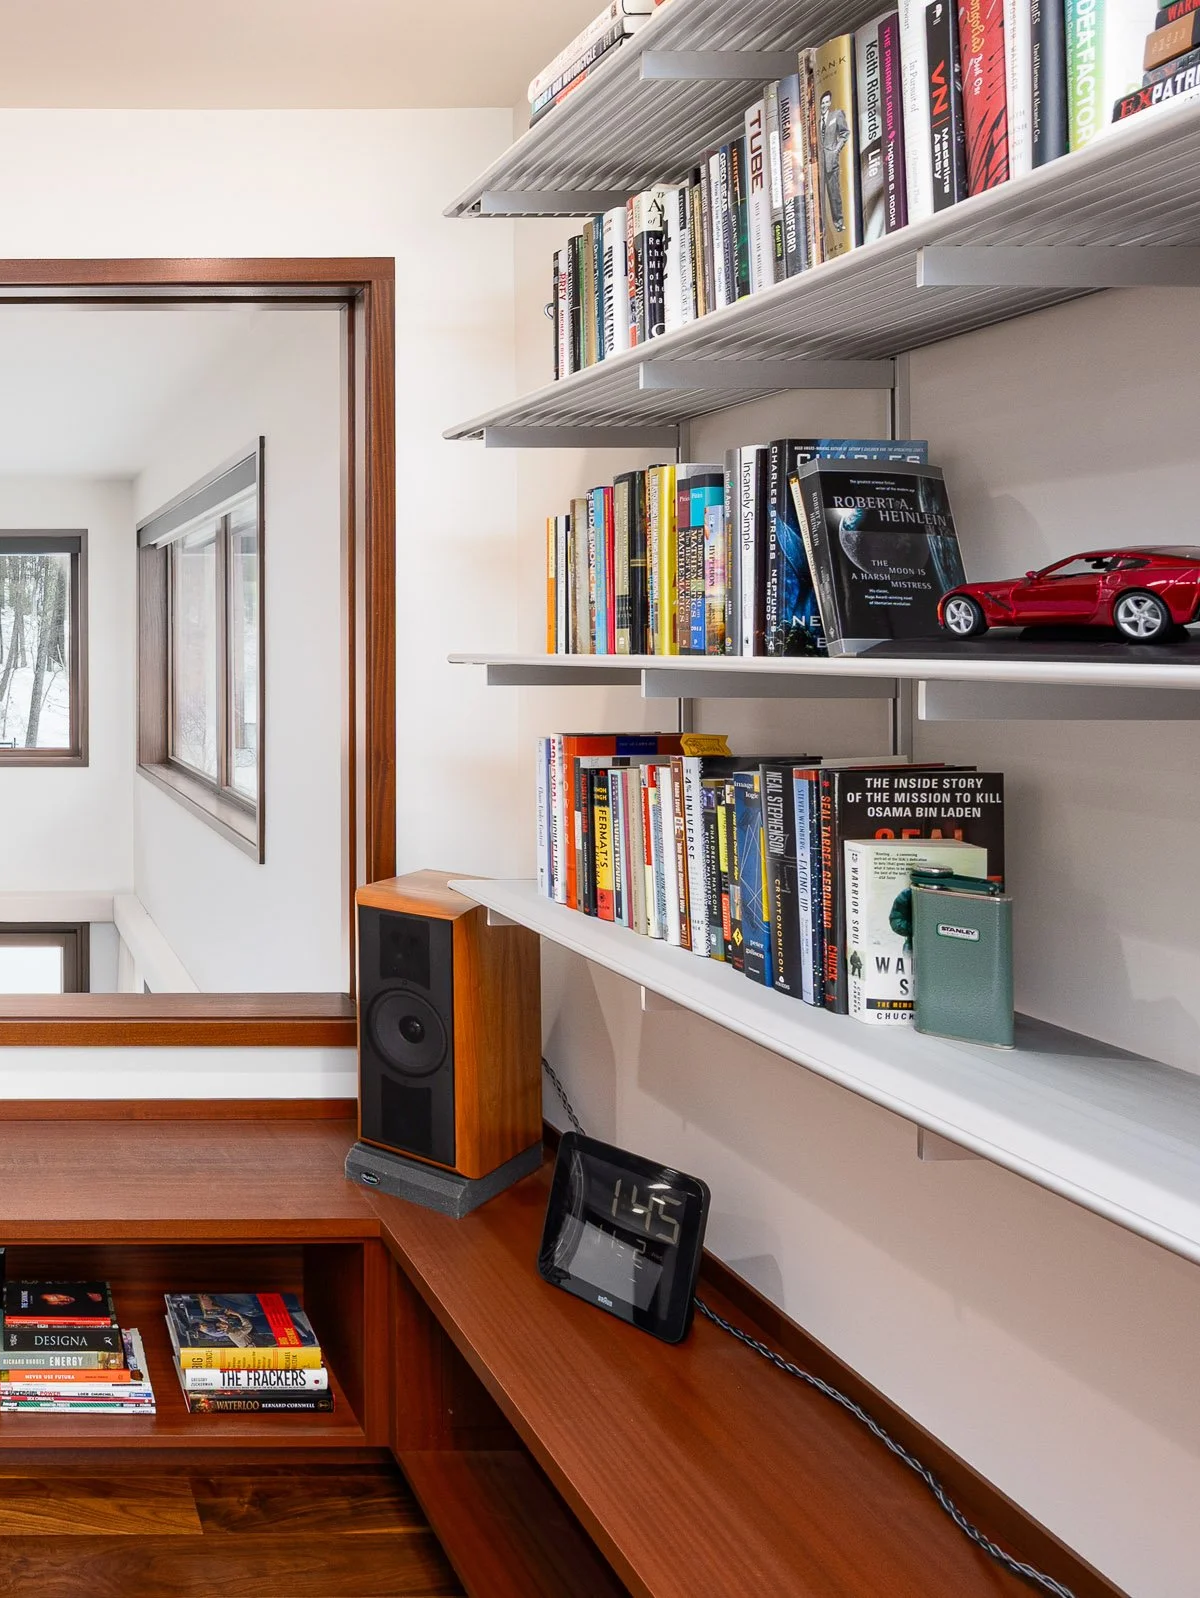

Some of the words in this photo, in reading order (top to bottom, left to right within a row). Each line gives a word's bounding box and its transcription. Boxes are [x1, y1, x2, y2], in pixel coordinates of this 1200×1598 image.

[865, 39, 878, 72] Keith
[930, 60, 948, 116] VN
[781, 97, 790, 140] JARHEAD
[867, 74, 878, 141] Richards
[750, 110, 763, 195] TUBE
[867, 148, 878, 178] Life
[933, 133, 943, 179] Ashby
[942, 128, 951, 194] Madeline
[783, 150, 792, 194] ANTHONY
[785, 198, 796, 253] SWOFFORD
[742, 461, 752, 510] Insanely
[770, 447, 778, 504] CHARLES
[724, 495, 732, 518] Apple
[833, 496, 894, 509] ROBERT
[900, 499, 913, 510] A.
[879, 510, 947, 526] HEINLEIN
[741, 512, 751, 550] Simple
[810, 512, 819, 546] HEINLEIN
[708, 545, 716, 587] HYPERION
[891, 581, 932, 589] MISTRESS
[766, 771, 782, 794] NEAL
[847, 792, 862, 803] OF
[866, 793, 890, 803] THE
[894, 793, 950, 803] MISSION
[956, 793, 970, 803] TO
[977, 793, 1002, 803] KILL
[866, 778, 890, 788] THE
[894, 778, 938, 788] INSIDE
[943, 778, 983, 788] STORY
[767, 796, 784, 854] STEPHENSON
[867, 807, 912, 817] OSAMA
[916, 807, 938, 817] BIN
[942, 807, 981, 817] LADEN
[598, 809, 608, 868] FERMAT'S
[799, 860, 807, 895] FACING
[800, 897, 808, 912] UP
[775, 879, 784, 973] CRYPTONOMICON
[941, 925, 976, 936] STANLEY
[828, 945, 838, 980] CHUCK
[34, 1336, 88, 1346] DESIGNA
[220, 1371, 242, 1386] THE
[247, 1370, 306, 1387] FRACKERS
[216, 1401, 259, 1410] WATERLOO
